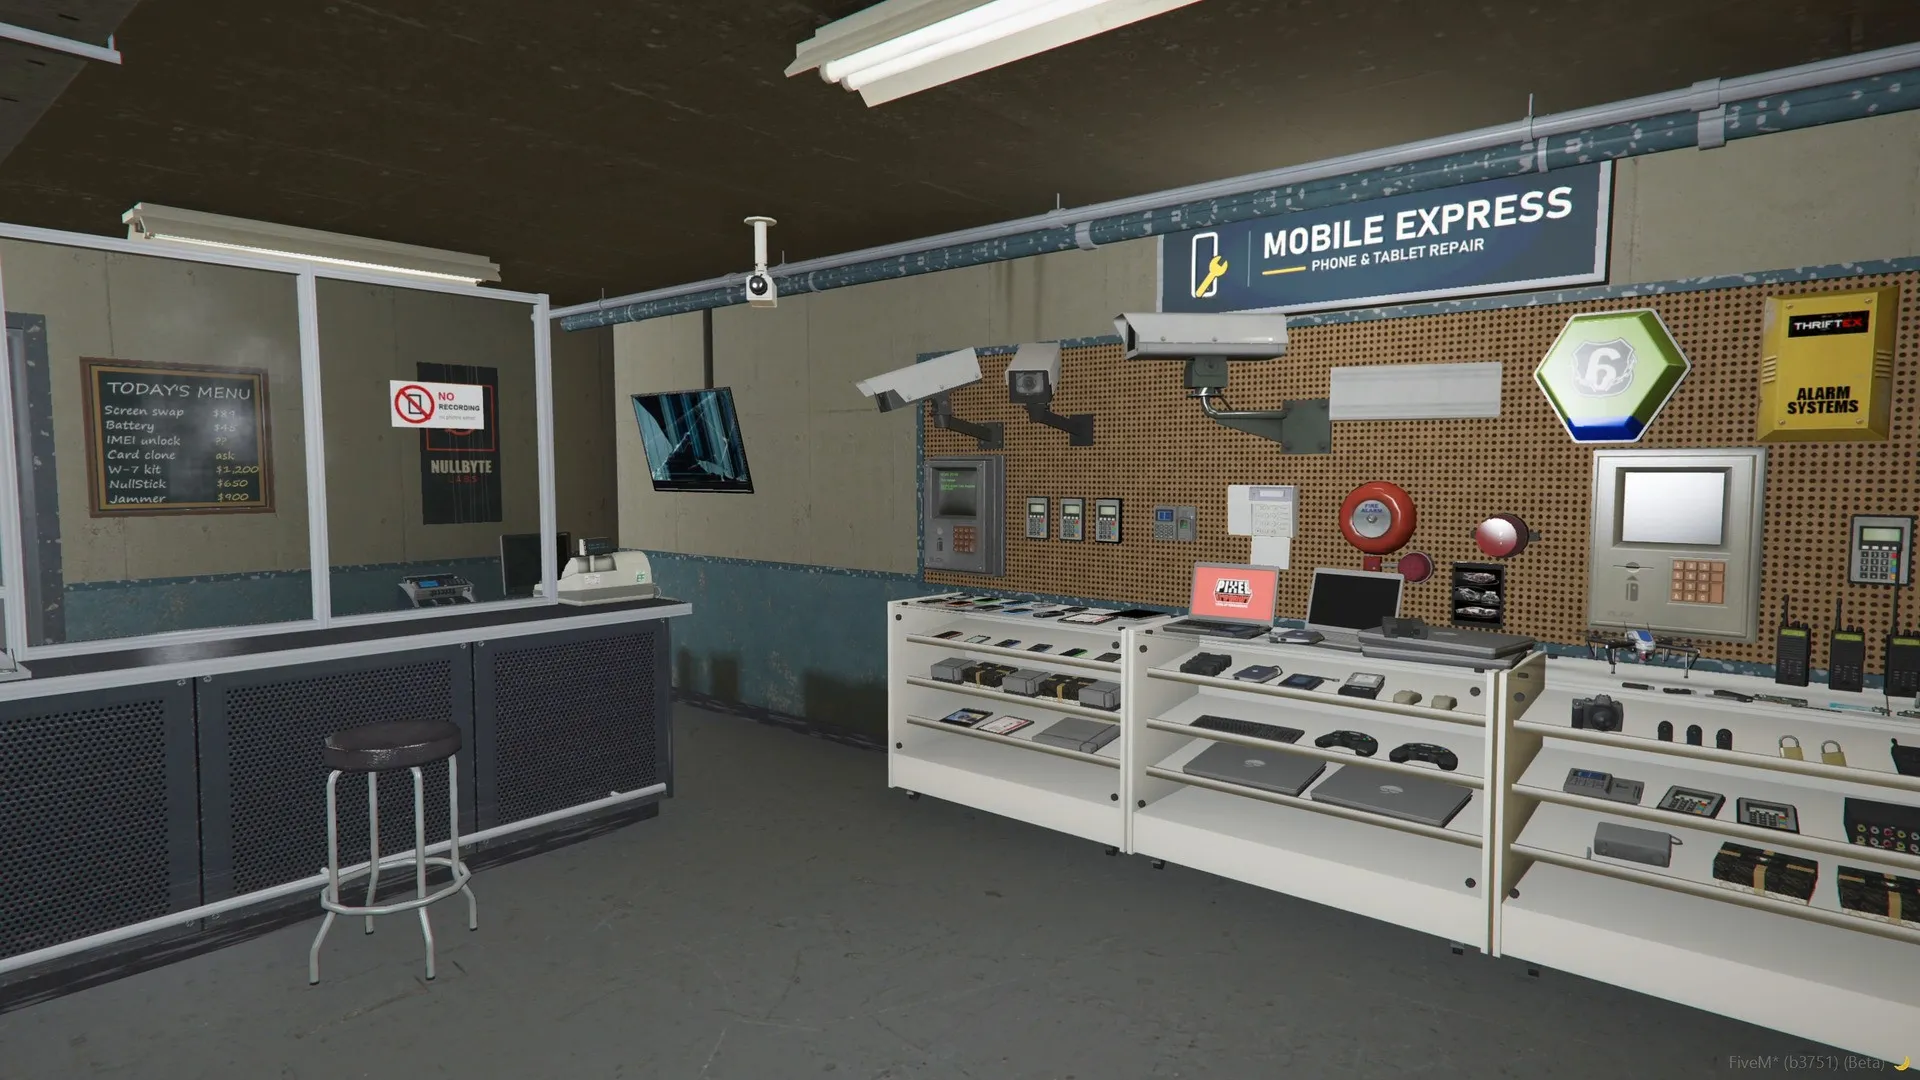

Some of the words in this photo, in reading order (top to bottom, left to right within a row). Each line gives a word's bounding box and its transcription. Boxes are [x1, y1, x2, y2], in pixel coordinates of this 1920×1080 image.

[1264, 214, 1385, 259] MOBILE
[1396, 186, 1573, 241] EXPRESS
[1312, 254, 1357, 272] PHONE
[1361, 253, 1370, 266] &
[1373, 246, 1427, 264] TABLET
[1429, 238, 1485, 257] REPAIR
[1794, 318, 1863, 331] THRIFTEX
[107, 381, 191, 398] TODAY'S
[197, 386, 251, 401] MENU
[438, 391, 455, 401] NO
[1796, 386, 1851, 400] ALARM
[104, 405, 148, 417] Screen
[152, 408, 185, 418] swap
[438, 403, 481, 412] RECORDING
[1787, 400, 1859, 415] SYSTEMS
[105, 420, 155, 434] Battery
[106, 435, 136, 445] IMEI
[140, 434, 181, 447] unlock
[107, 449, 140, 461] Card
[144, 450, 176, 461] clone
[215, 450, 236, 461] ask
[108, 465, 140, 475] W-7
[144, 463, 162, 475] kit
[215, 465, 260, 475] $1,200
[431, 459, 493, 474] NULLBYTE
[109, 478, 167, 490] NullStick
[216, 478, 249, 488] $650
[109, 494, 167, 505] Jammer
[217, 492, 250, 503] $900
[1216, 580, 1251, 595] PIXEL
